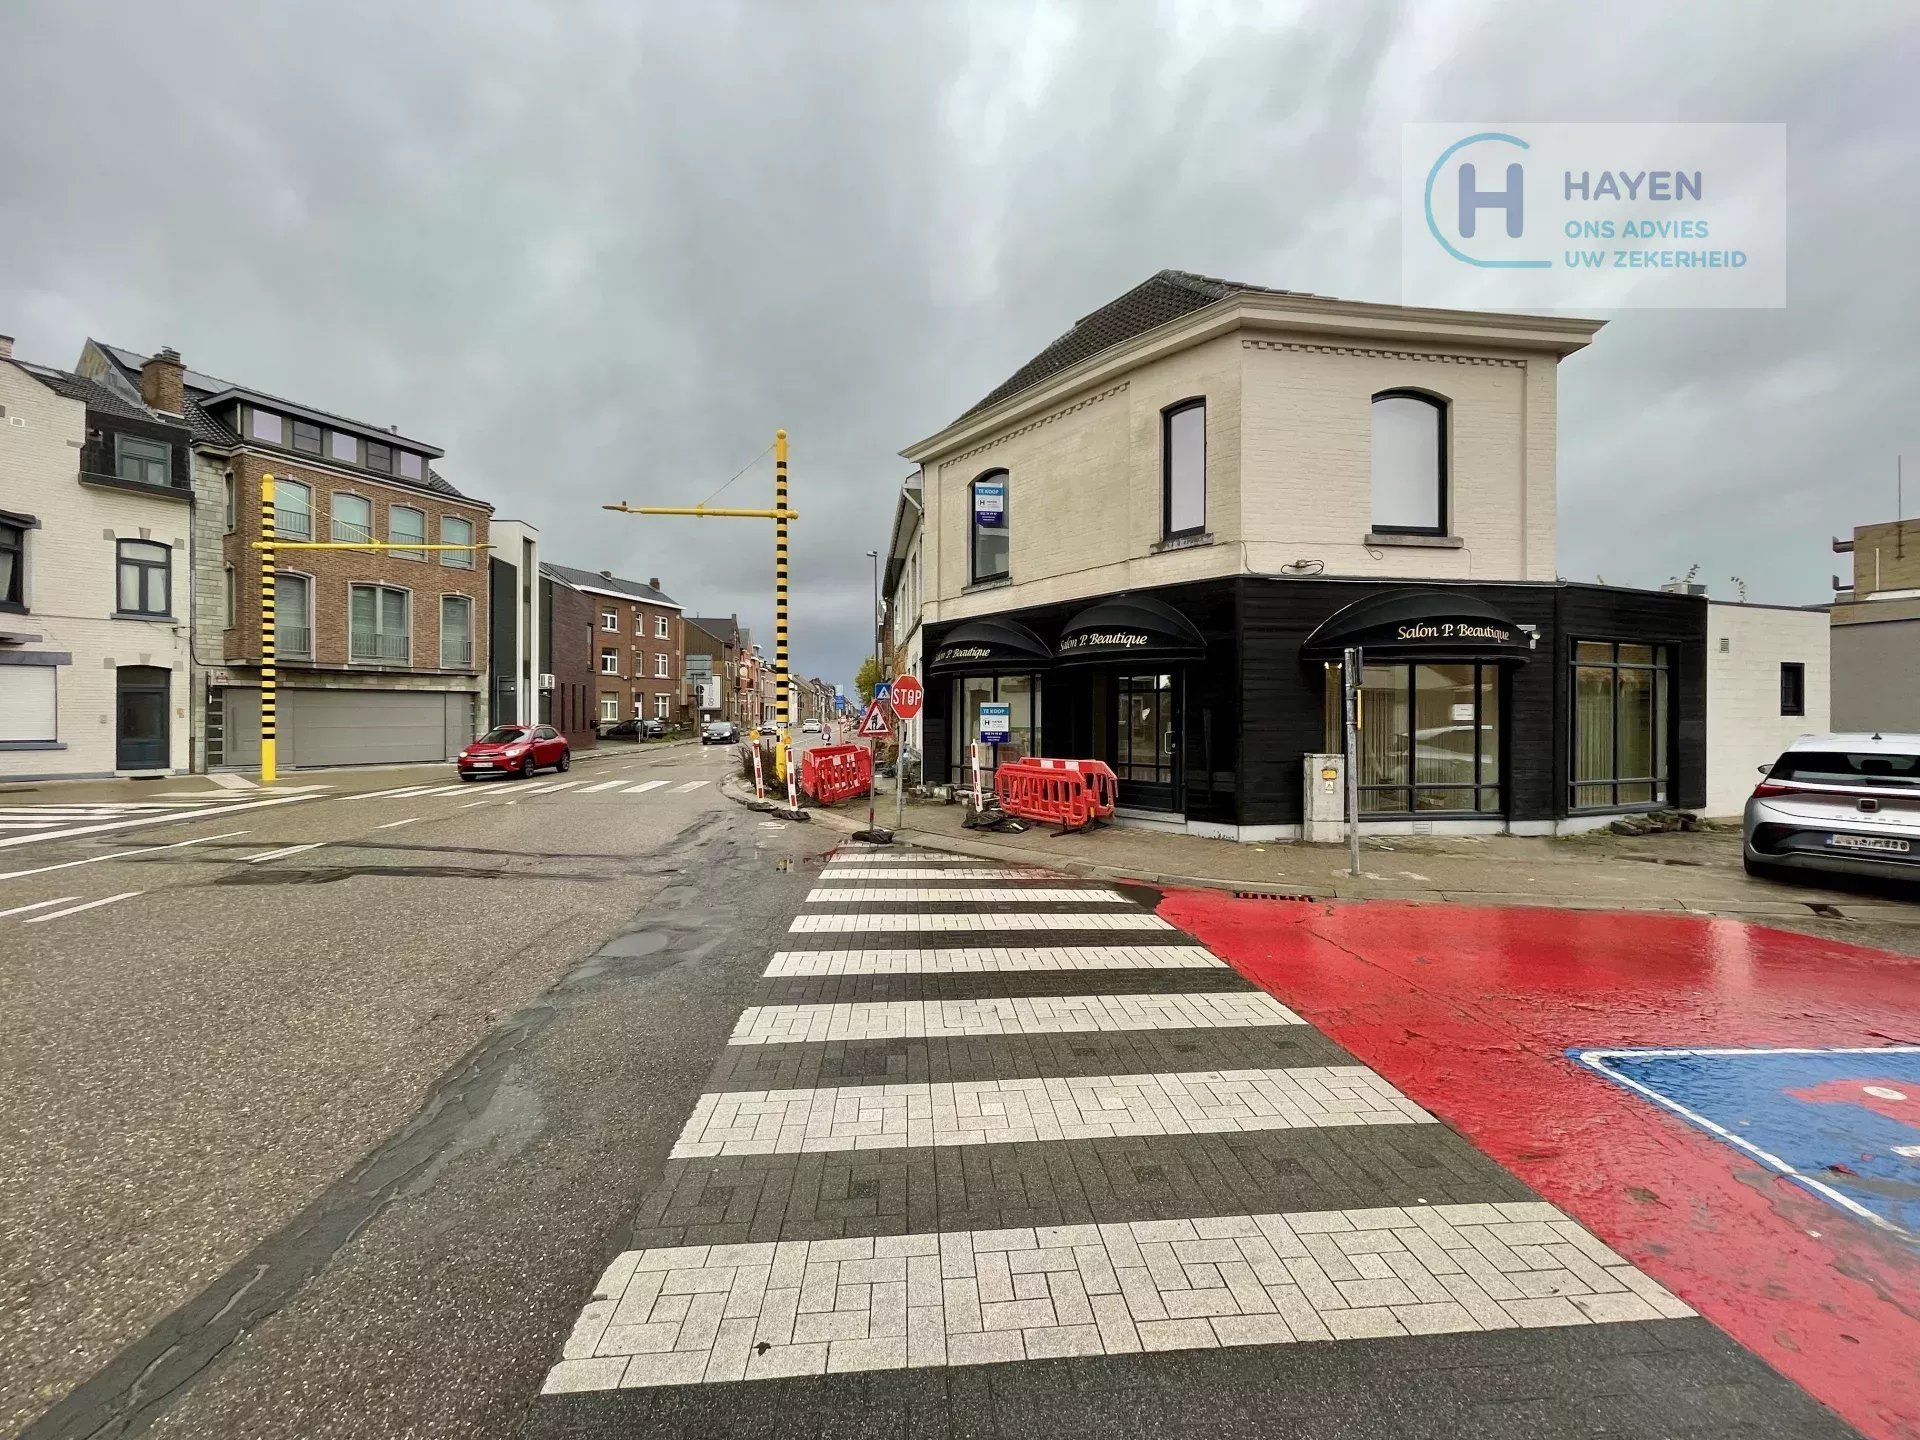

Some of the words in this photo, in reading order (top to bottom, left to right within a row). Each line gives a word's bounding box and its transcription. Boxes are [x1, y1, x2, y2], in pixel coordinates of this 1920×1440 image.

[1059, 635, 1078, 652] Salon
[1079, 634, 1088, 647] P.
[1089, 631, 1148, 648] Beautique
[1397, 622, 1439, 640] Salon
[1441, 623, 1454, 637] P.
[1457, 623, 1510, 643] Beautique
[952, 646, 991, 660] Beautique
[893, 688, 922, 706] STOP
